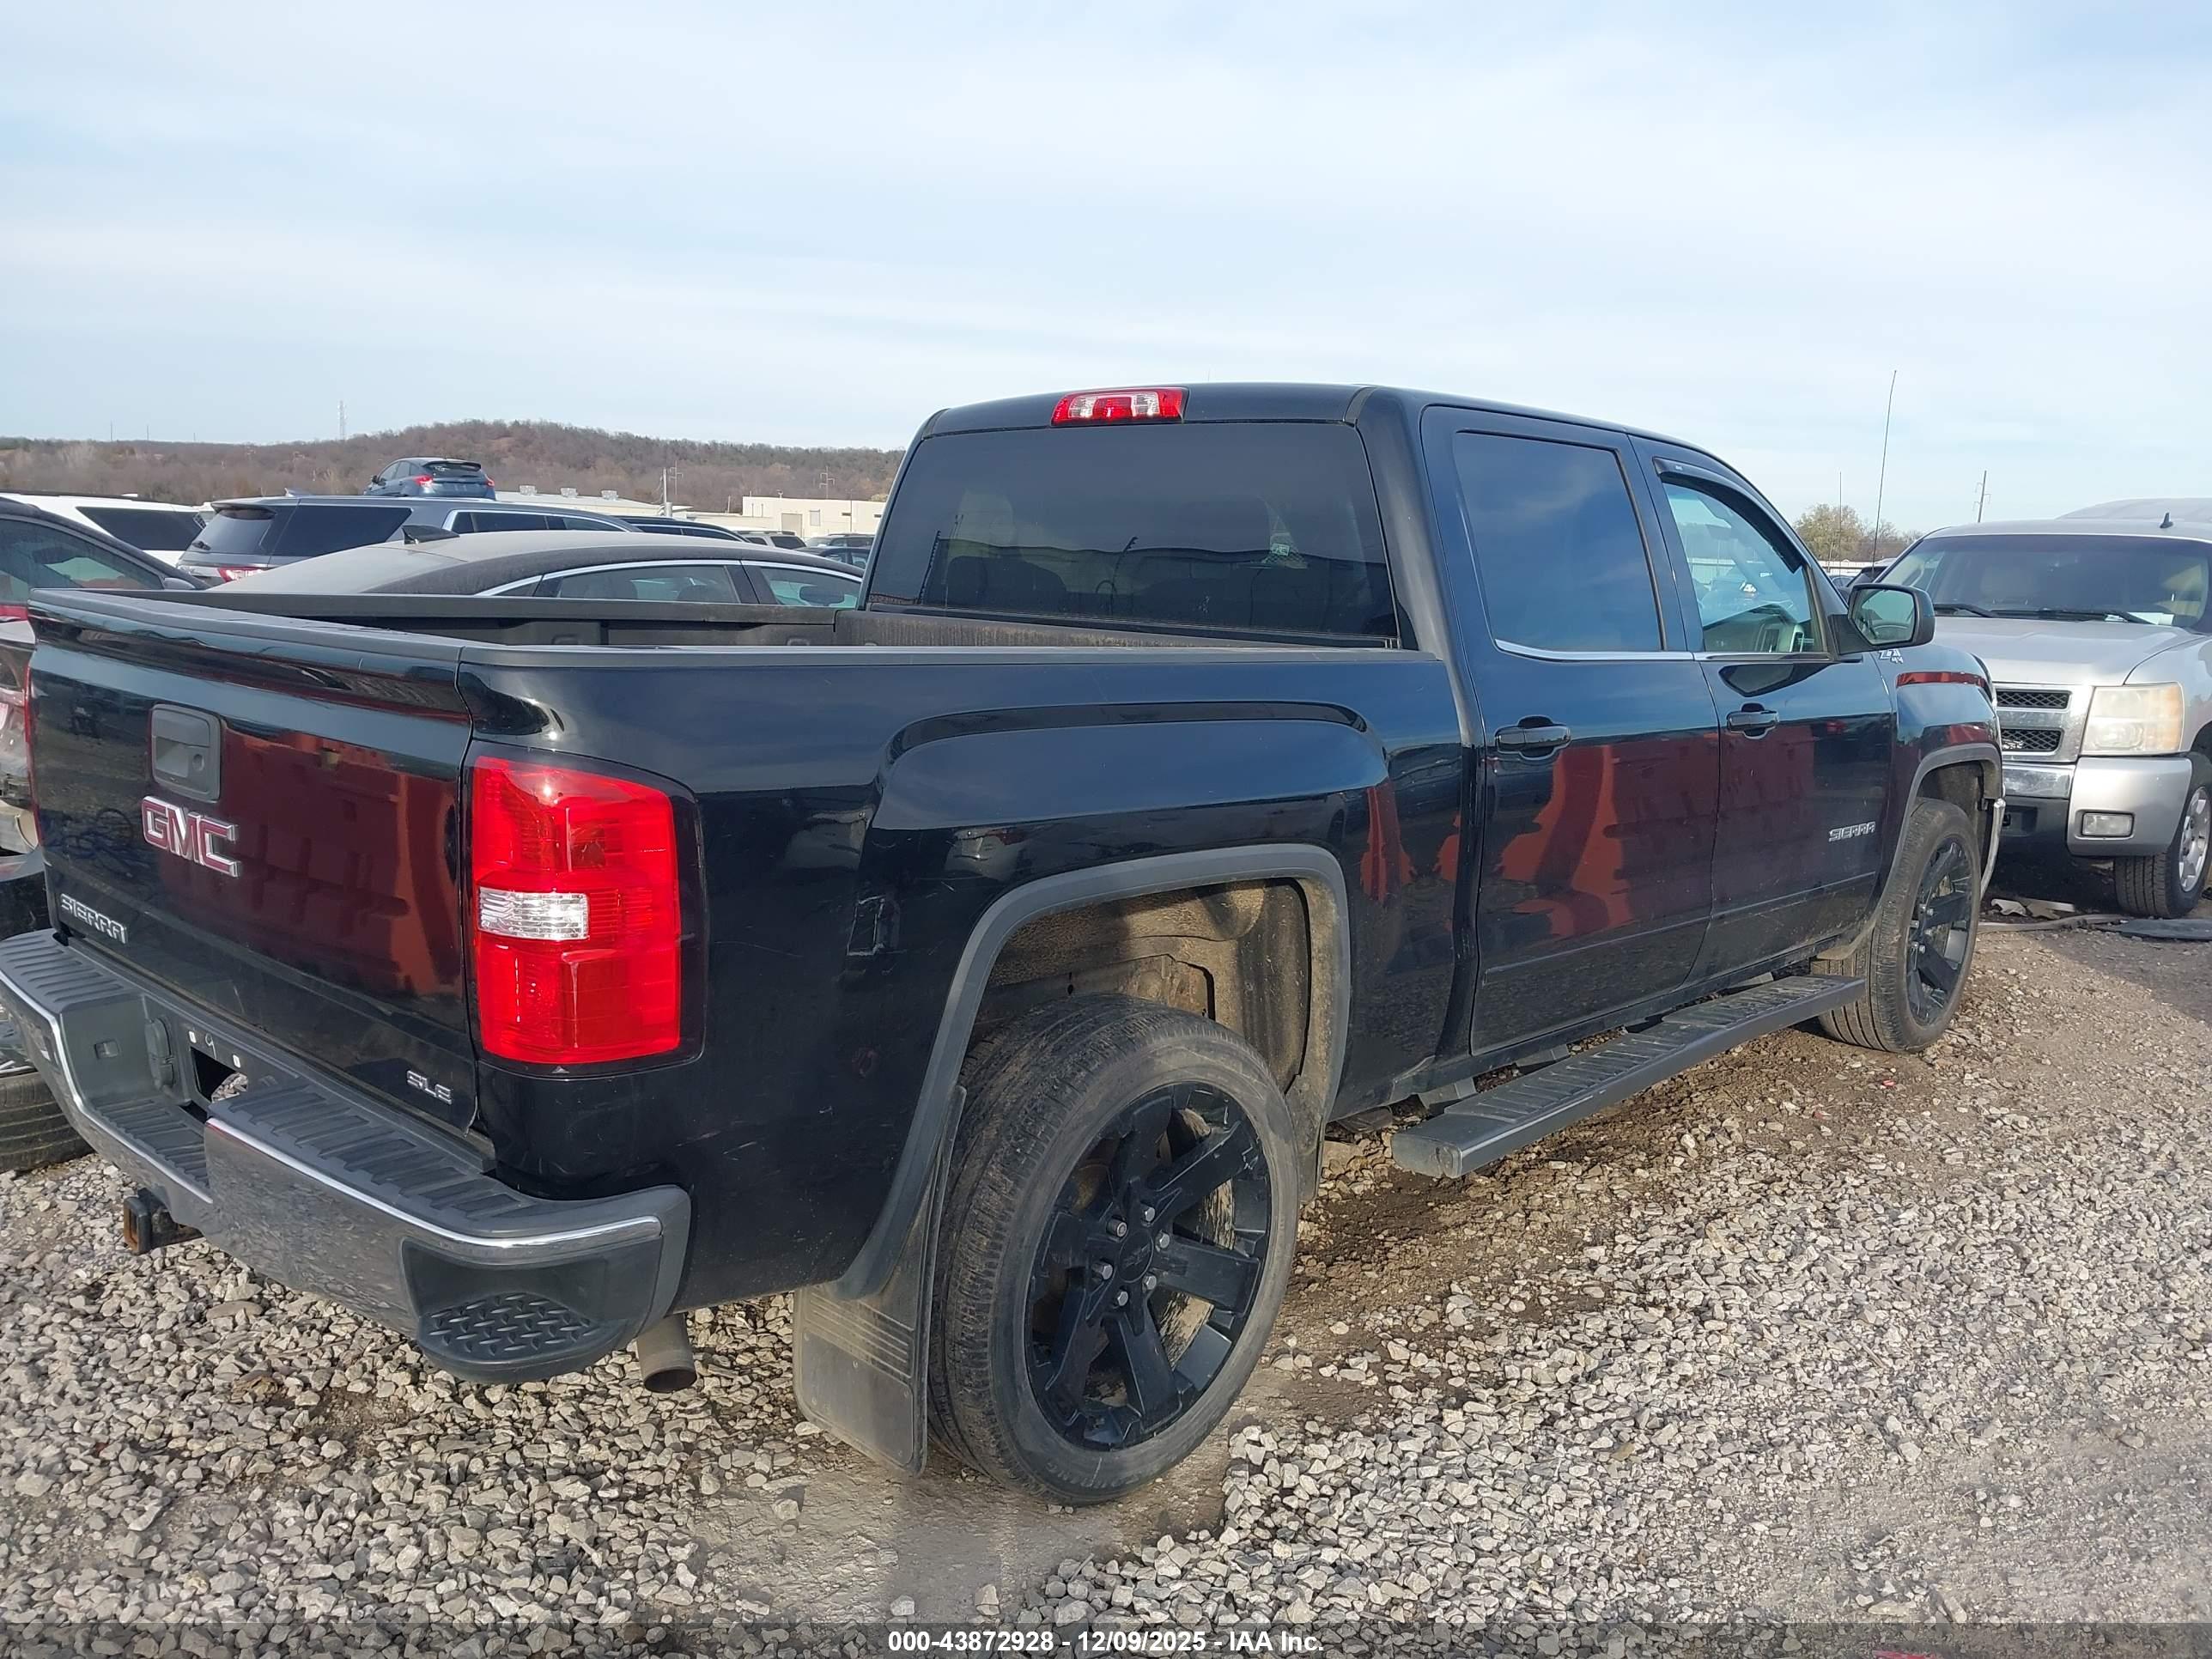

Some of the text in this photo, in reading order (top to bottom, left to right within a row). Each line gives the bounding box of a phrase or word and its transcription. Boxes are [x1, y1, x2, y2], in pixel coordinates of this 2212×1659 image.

[142, 795, 241, 878] GMC
[1828, 821, 1876, 842] SIERRA
[60, 893, 128, 945] SIERRA
[406, 1070, 453, 1105] SLE
